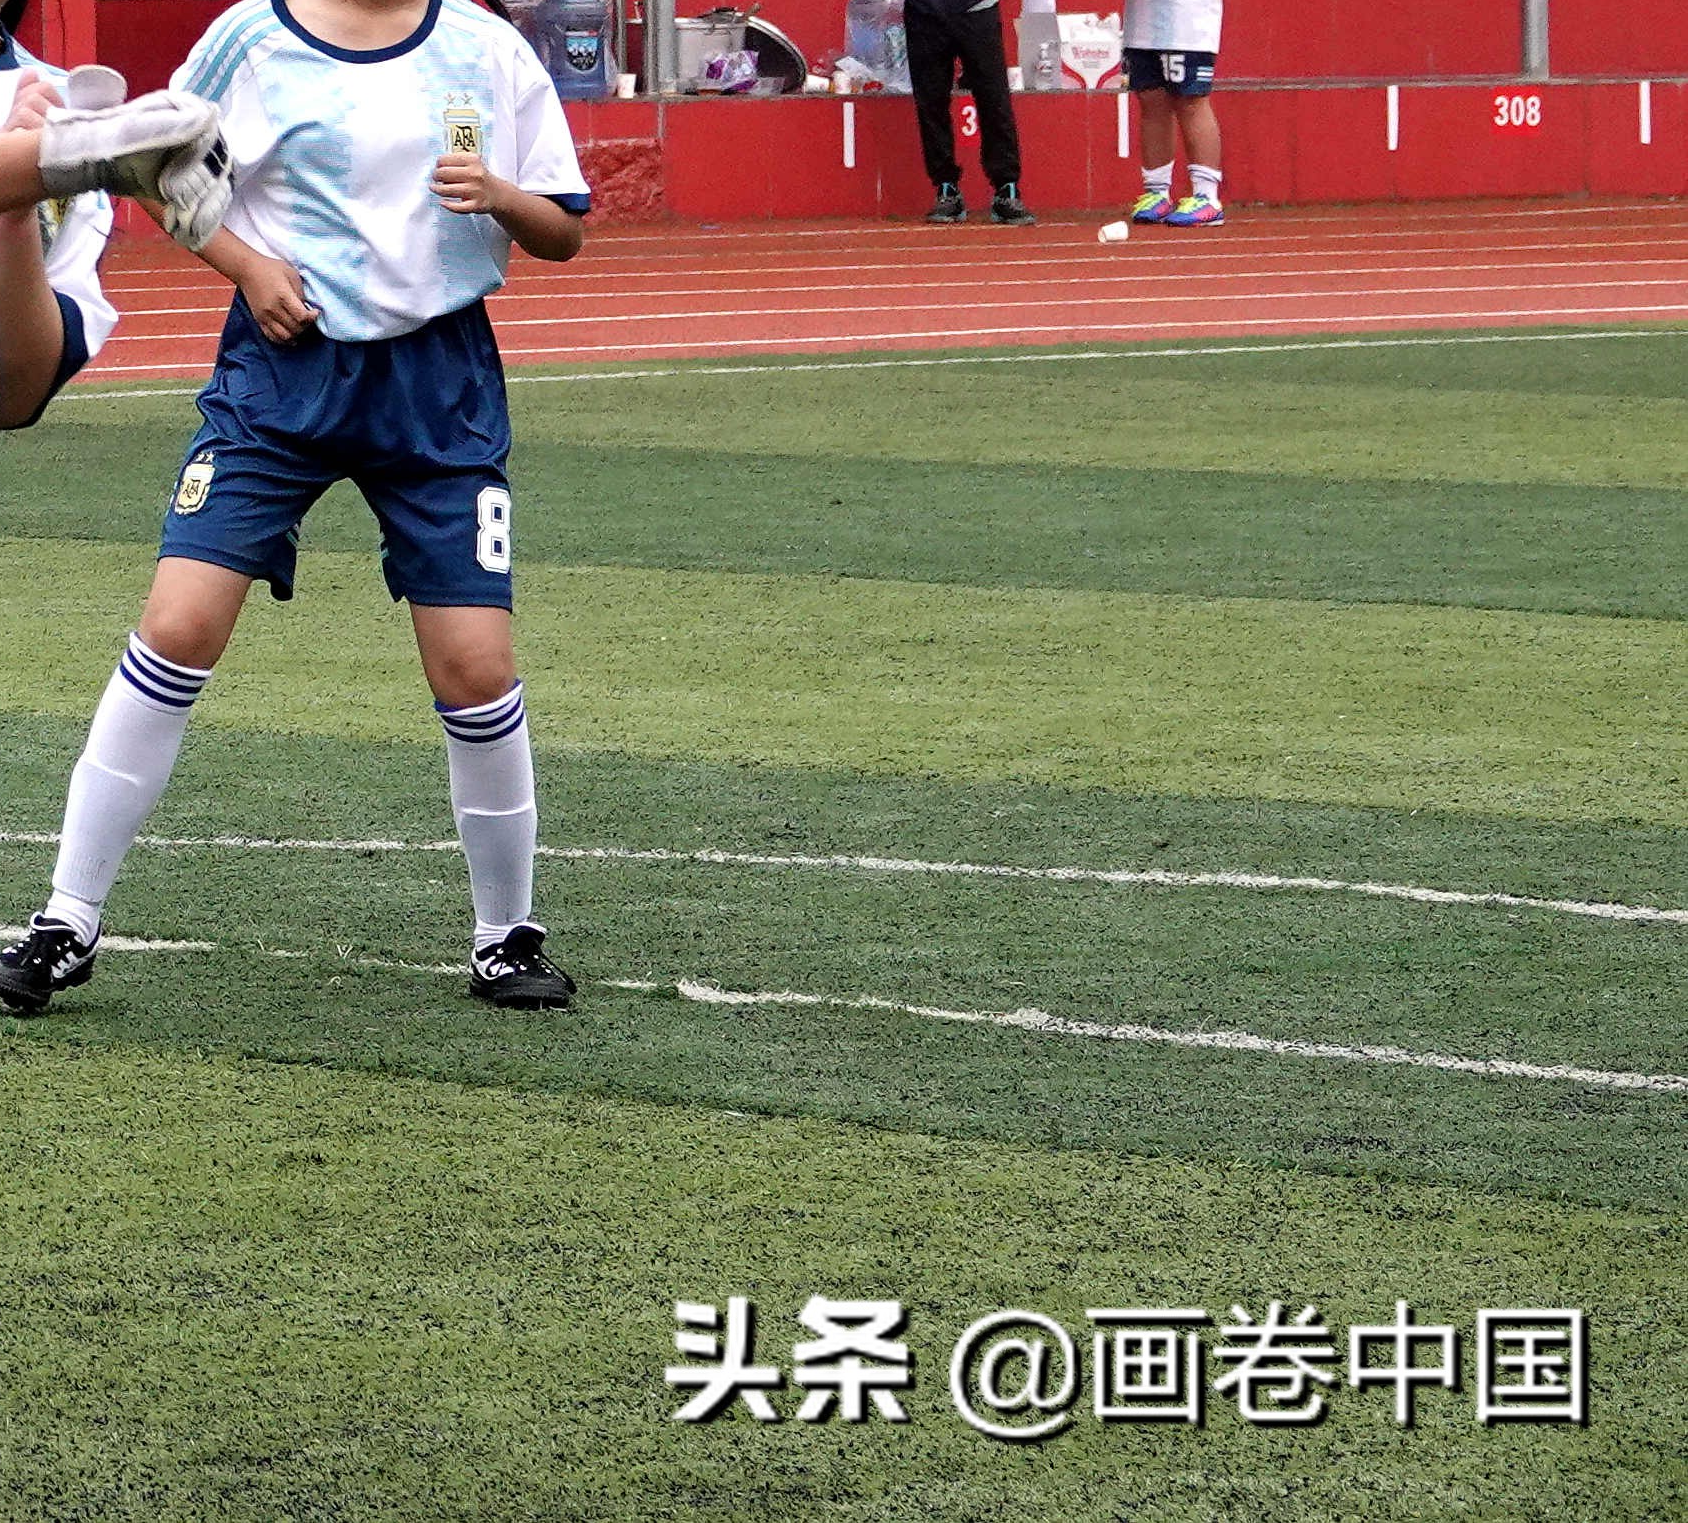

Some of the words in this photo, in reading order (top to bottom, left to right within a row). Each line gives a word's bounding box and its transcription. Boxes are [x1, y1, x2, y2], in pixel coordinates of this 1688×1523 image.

[1160, 53, 1187, 83] 15
[1495, 96, 1541, 126] 308
[476, 486, 512, 574] 8
